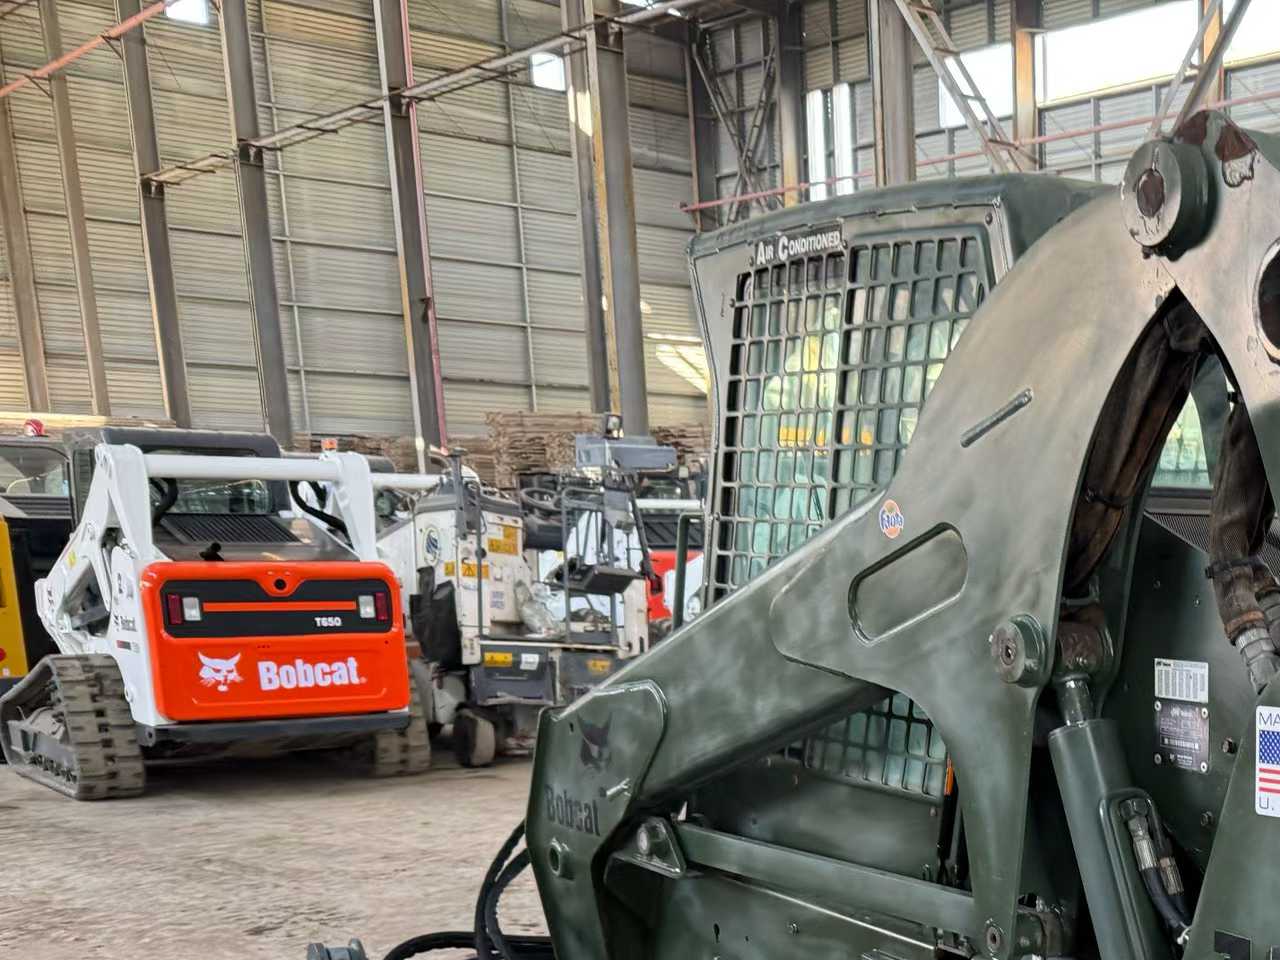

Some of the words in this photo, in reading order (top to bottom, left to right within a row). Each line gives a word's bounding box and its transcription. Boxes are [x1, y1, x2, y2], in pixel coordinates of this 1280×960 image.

[314, 616, 342, 627] T650
[257, 656, 361, 691] Bobcat
[544, 784, 601, 837] Bobcat
